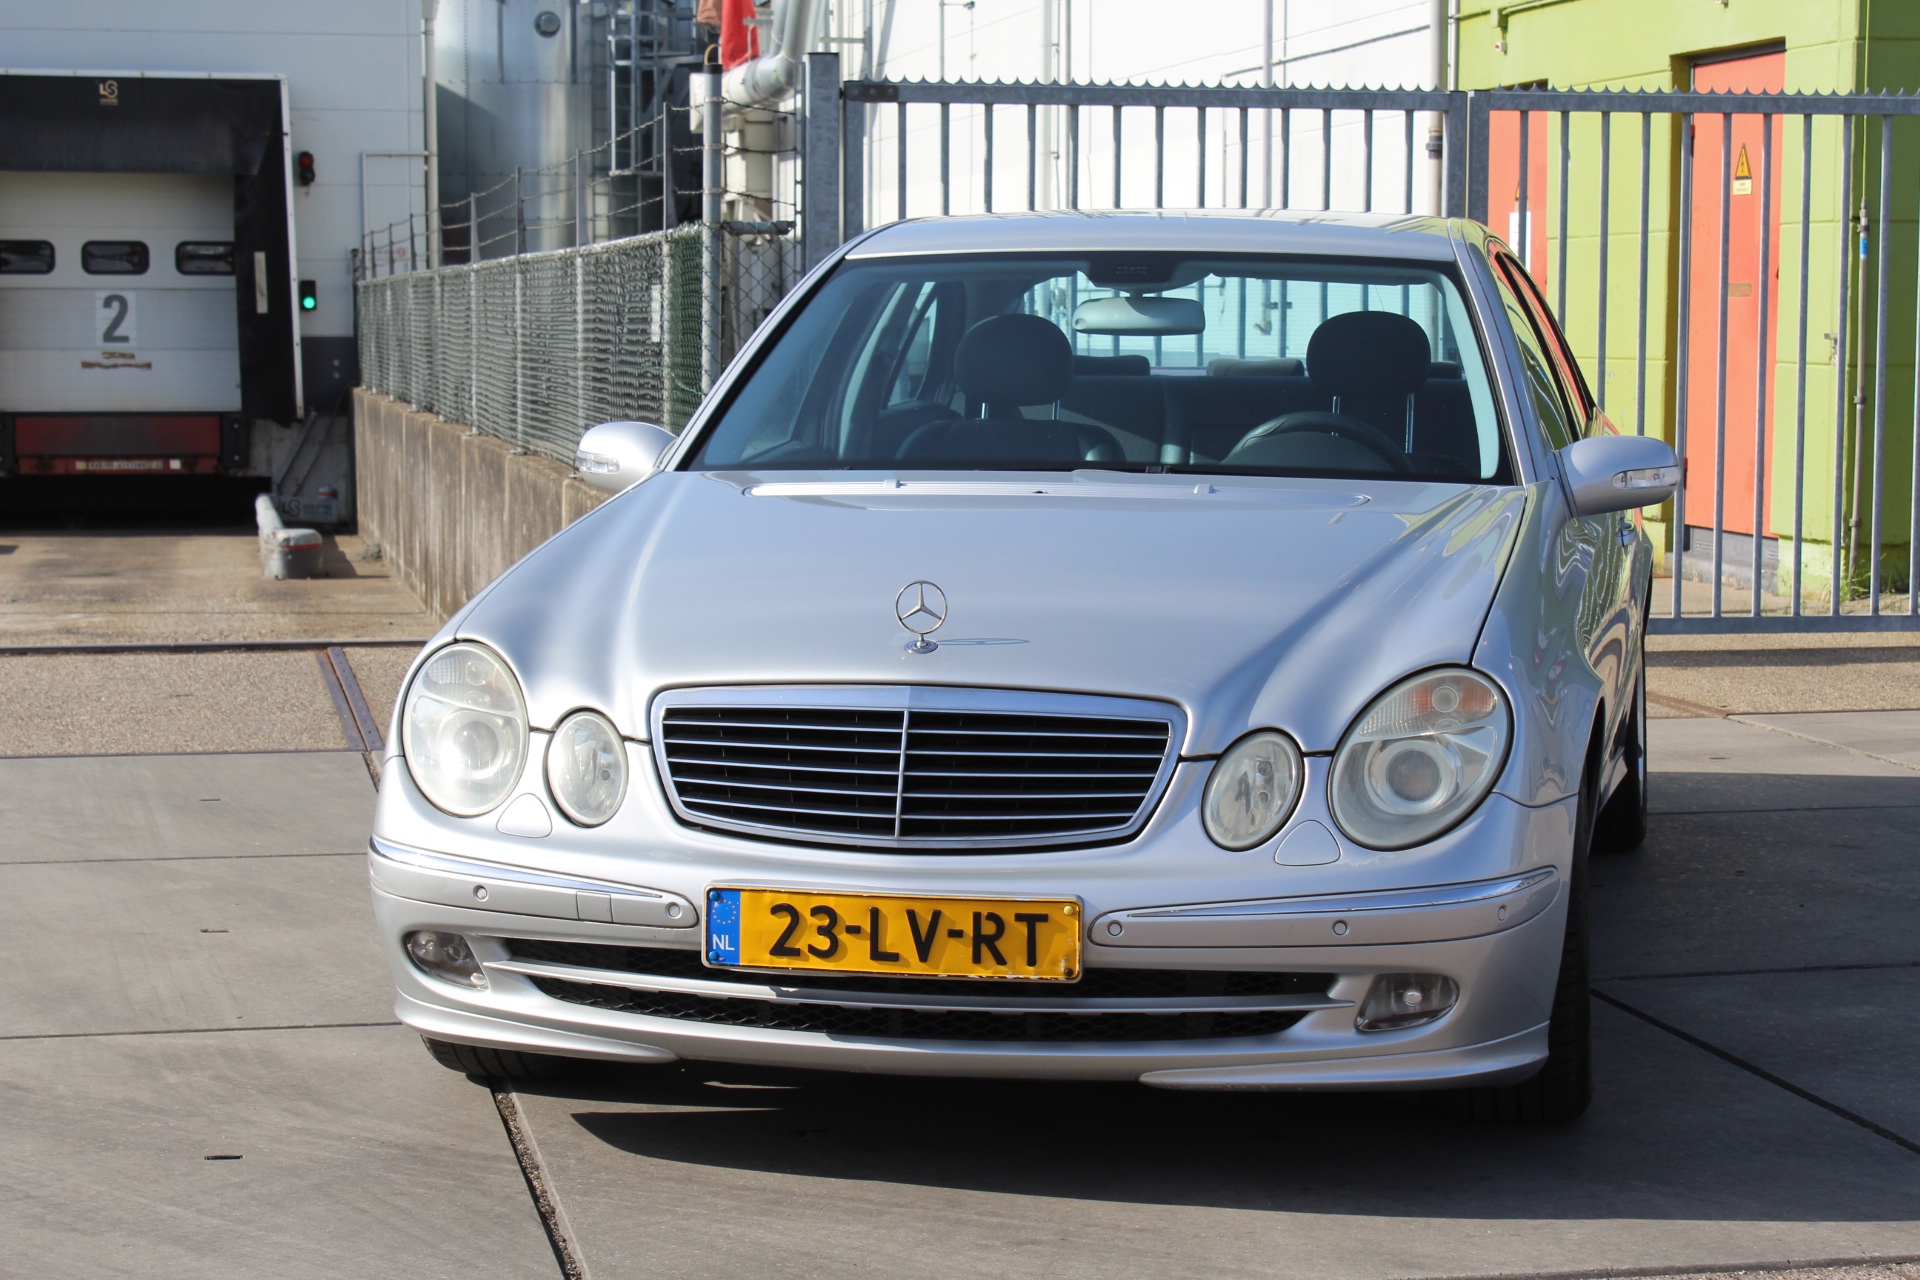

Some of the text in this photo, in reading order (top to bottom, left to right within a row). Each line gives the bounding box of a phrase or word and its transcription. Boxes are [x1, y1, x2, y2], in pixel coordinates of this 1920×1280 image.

[102, 294, 129, 343] 2
[712, 933, 735, 951] NL
[769, 903, 1049, 967] 23-LV-RT
